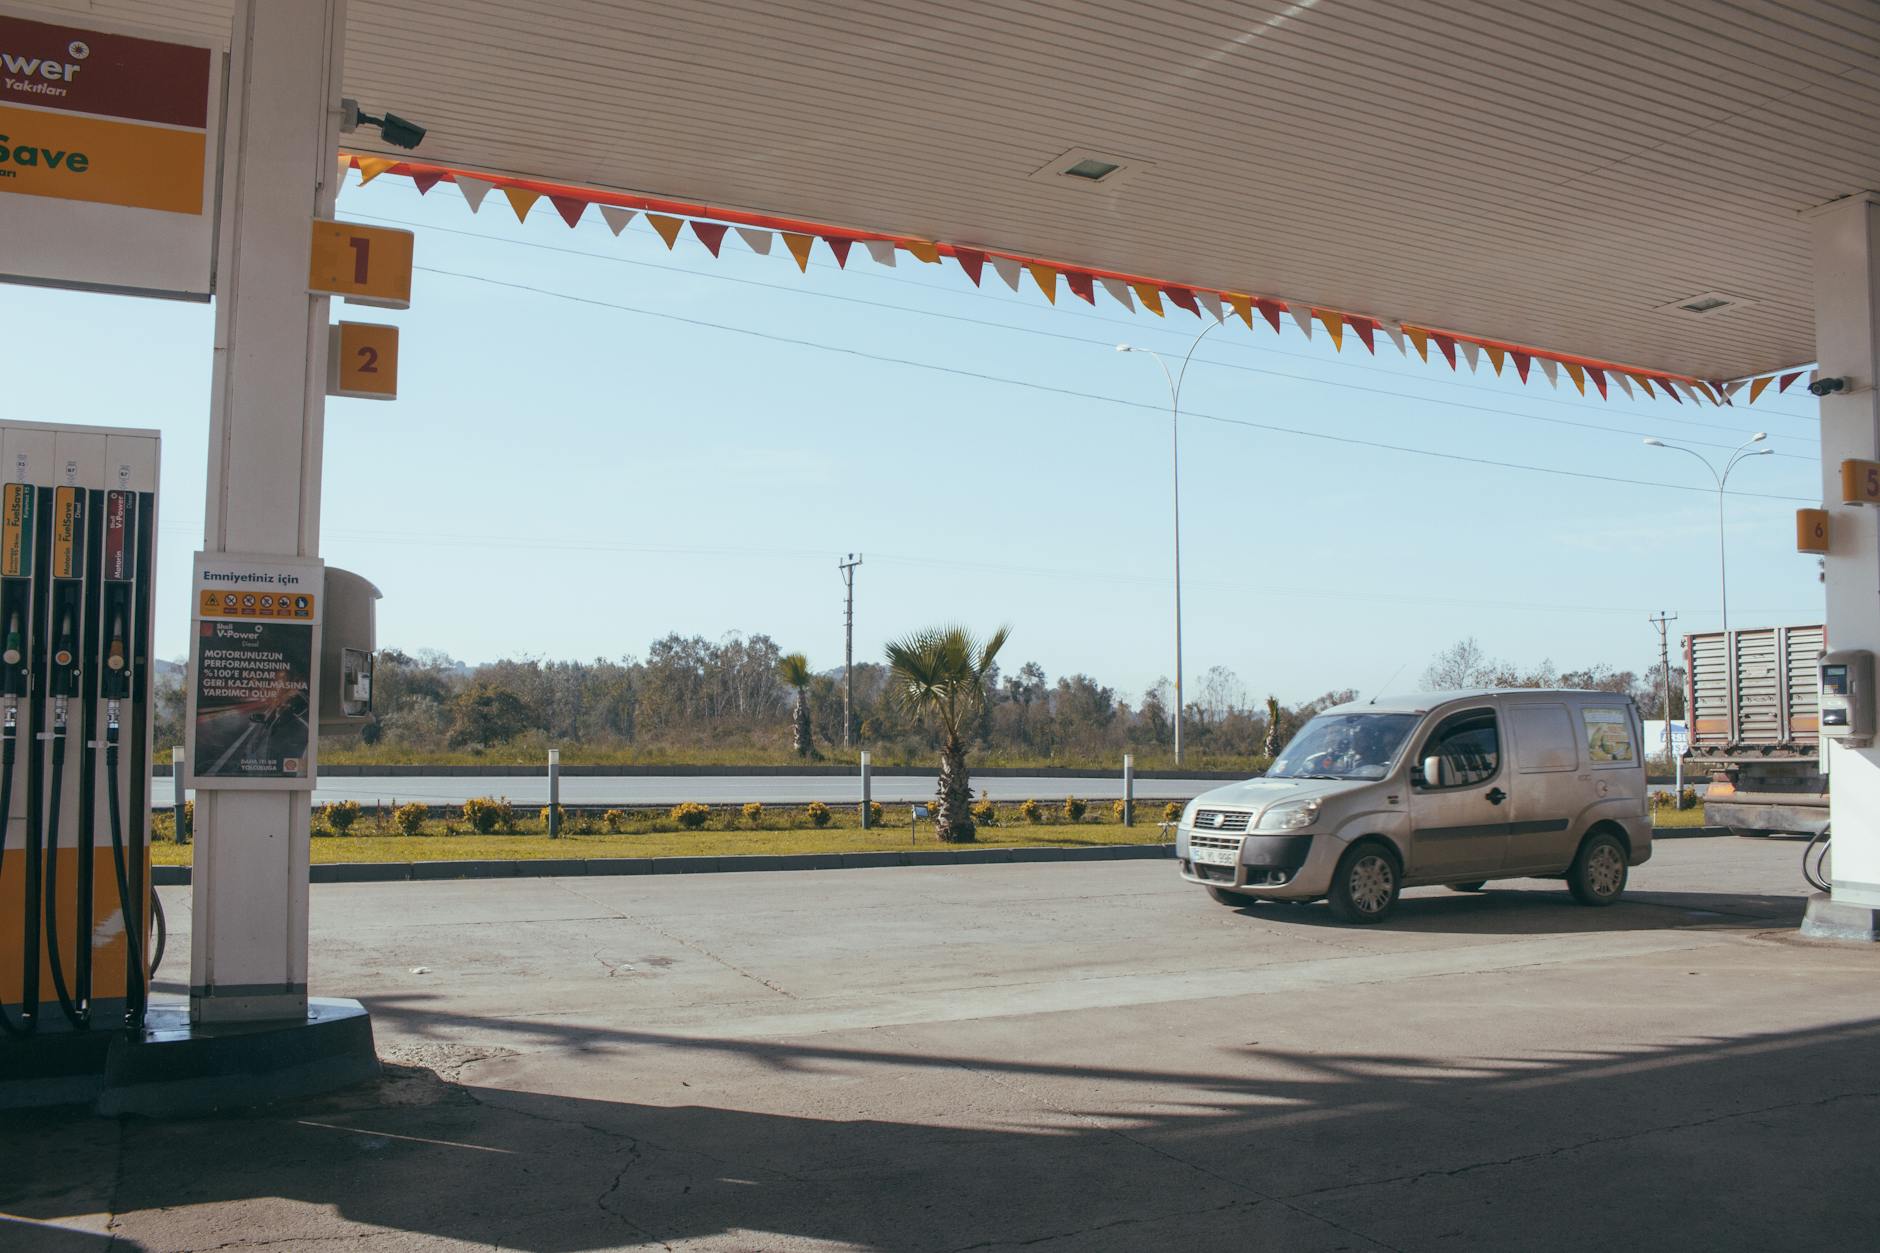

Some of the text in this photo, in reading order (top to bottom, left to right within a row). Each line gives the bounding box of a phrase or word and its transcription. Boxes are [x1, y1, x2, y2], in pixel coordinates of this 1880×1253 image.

[0, 53, 80, 82] wer
[5, 78, 67, 96] Yakıtları
[349, 236, 370, 285] 1
[357, 346, 378, 373] 2
[1866, 468, 1879, 497] 5
[11, 486, 22, 527] FuelSave
[63, 502, 73, 542] FuelSave
[1814, 522, 1823, 538] 6
[114, 550, 122, 578] Motorin
[203, 571, 299, 587] Emniyetiniz için
[217, 630, 259, 639] V-Power
[204, 650, 283, 660] MOTORUNUZUN
[204, 659, 291, 670] PERFORMANSININ
[242, 670, 275, 679] KADAR
[203, 689, 278, 698] YARDIMCI OLUR
[228, 680, 308, 690] KAZANILMASINA
